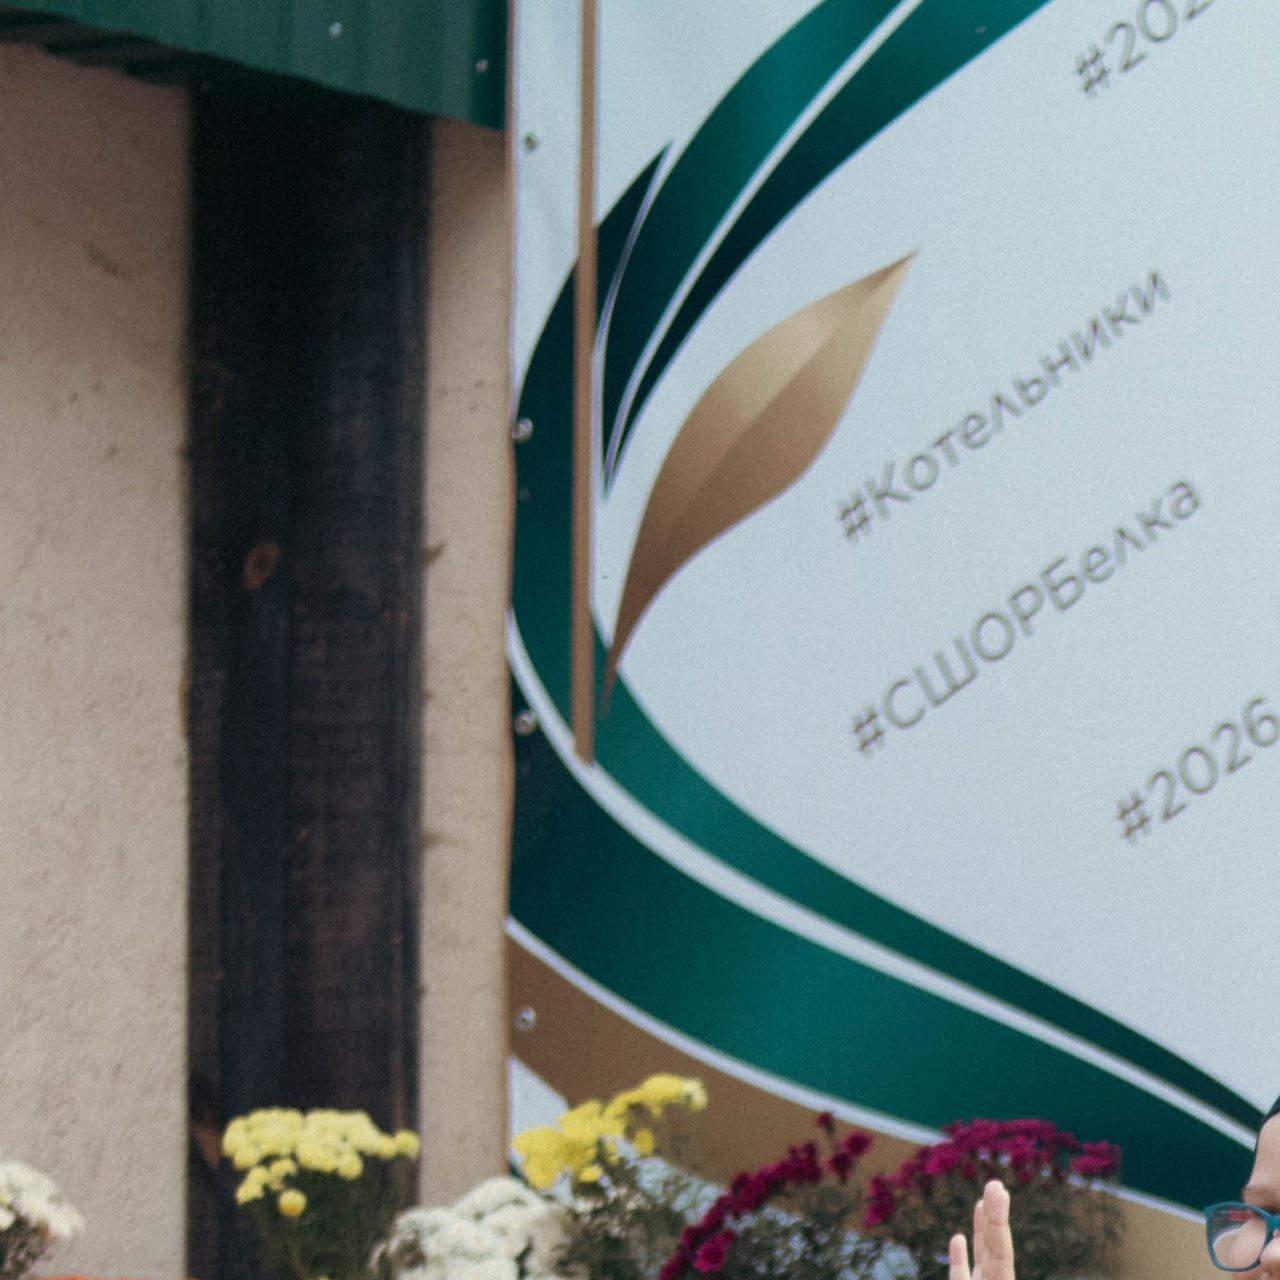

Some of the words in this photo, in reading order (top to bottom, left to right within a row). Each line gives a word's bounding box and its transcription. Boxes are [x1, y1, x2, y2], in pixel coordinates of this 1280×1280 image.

[1074, 0, 1206, 97] #20
[836, 271, 1170, 543] #Котельники
[851, 480, 1201, 756] #СШОРБелка
